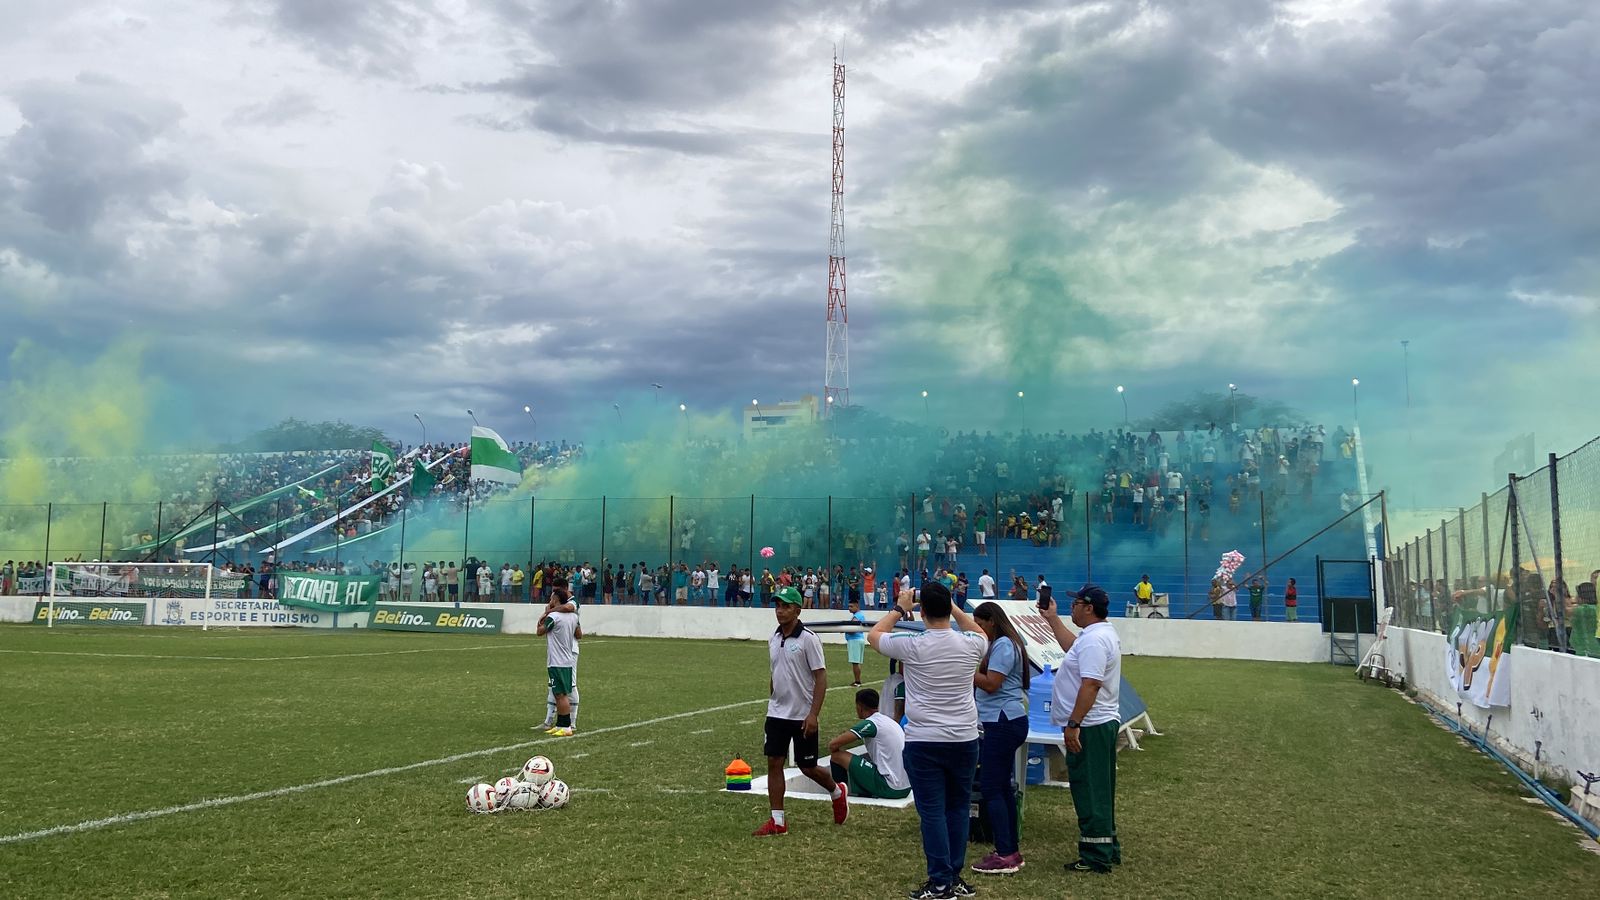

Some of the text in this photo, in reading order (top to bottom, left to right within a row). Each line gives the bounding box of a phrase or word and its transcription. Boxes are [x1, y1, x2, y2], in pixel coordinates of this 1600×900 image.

[345, 581, 370, 606] AC
[215, 601, 280, 611] SECRETARIA
[190, 611, 319, 624] ESPORTE E TURISMO
